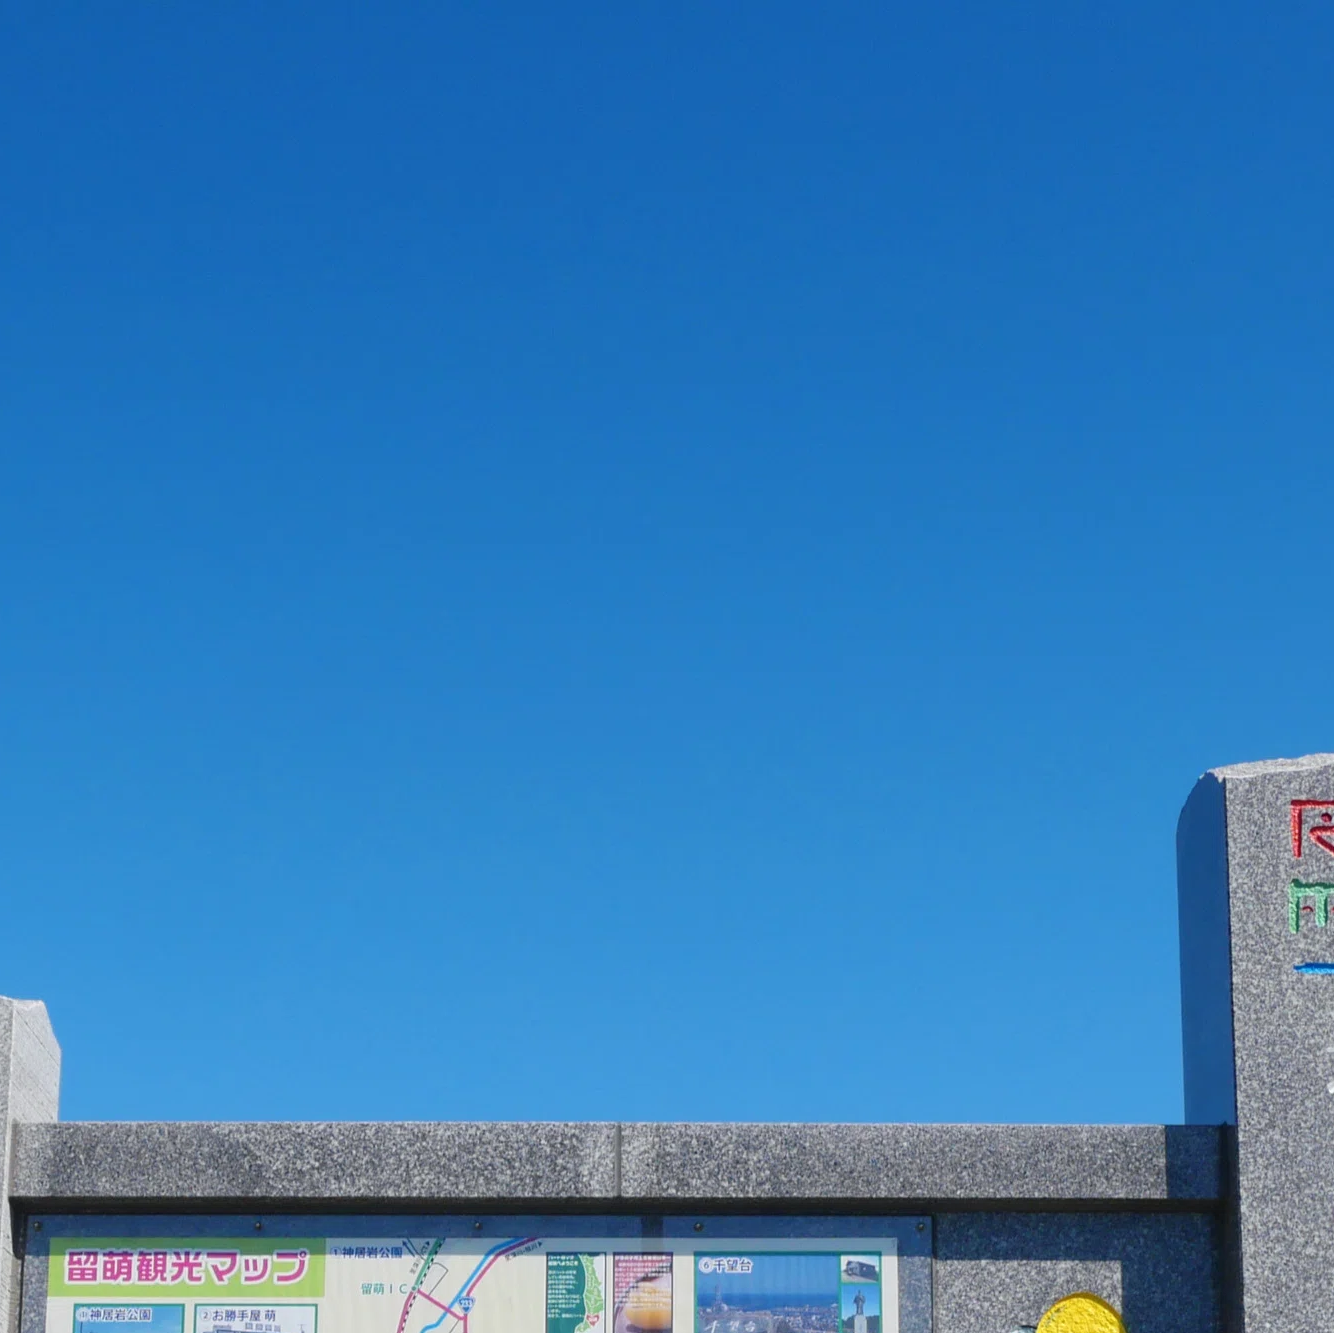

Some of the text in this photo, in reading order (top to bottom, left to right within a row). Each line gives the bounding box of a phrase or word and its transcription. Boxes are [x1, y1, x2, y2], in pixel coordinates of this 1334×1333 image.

[66, 1250, 308, 1284] 留萌観光マップ
